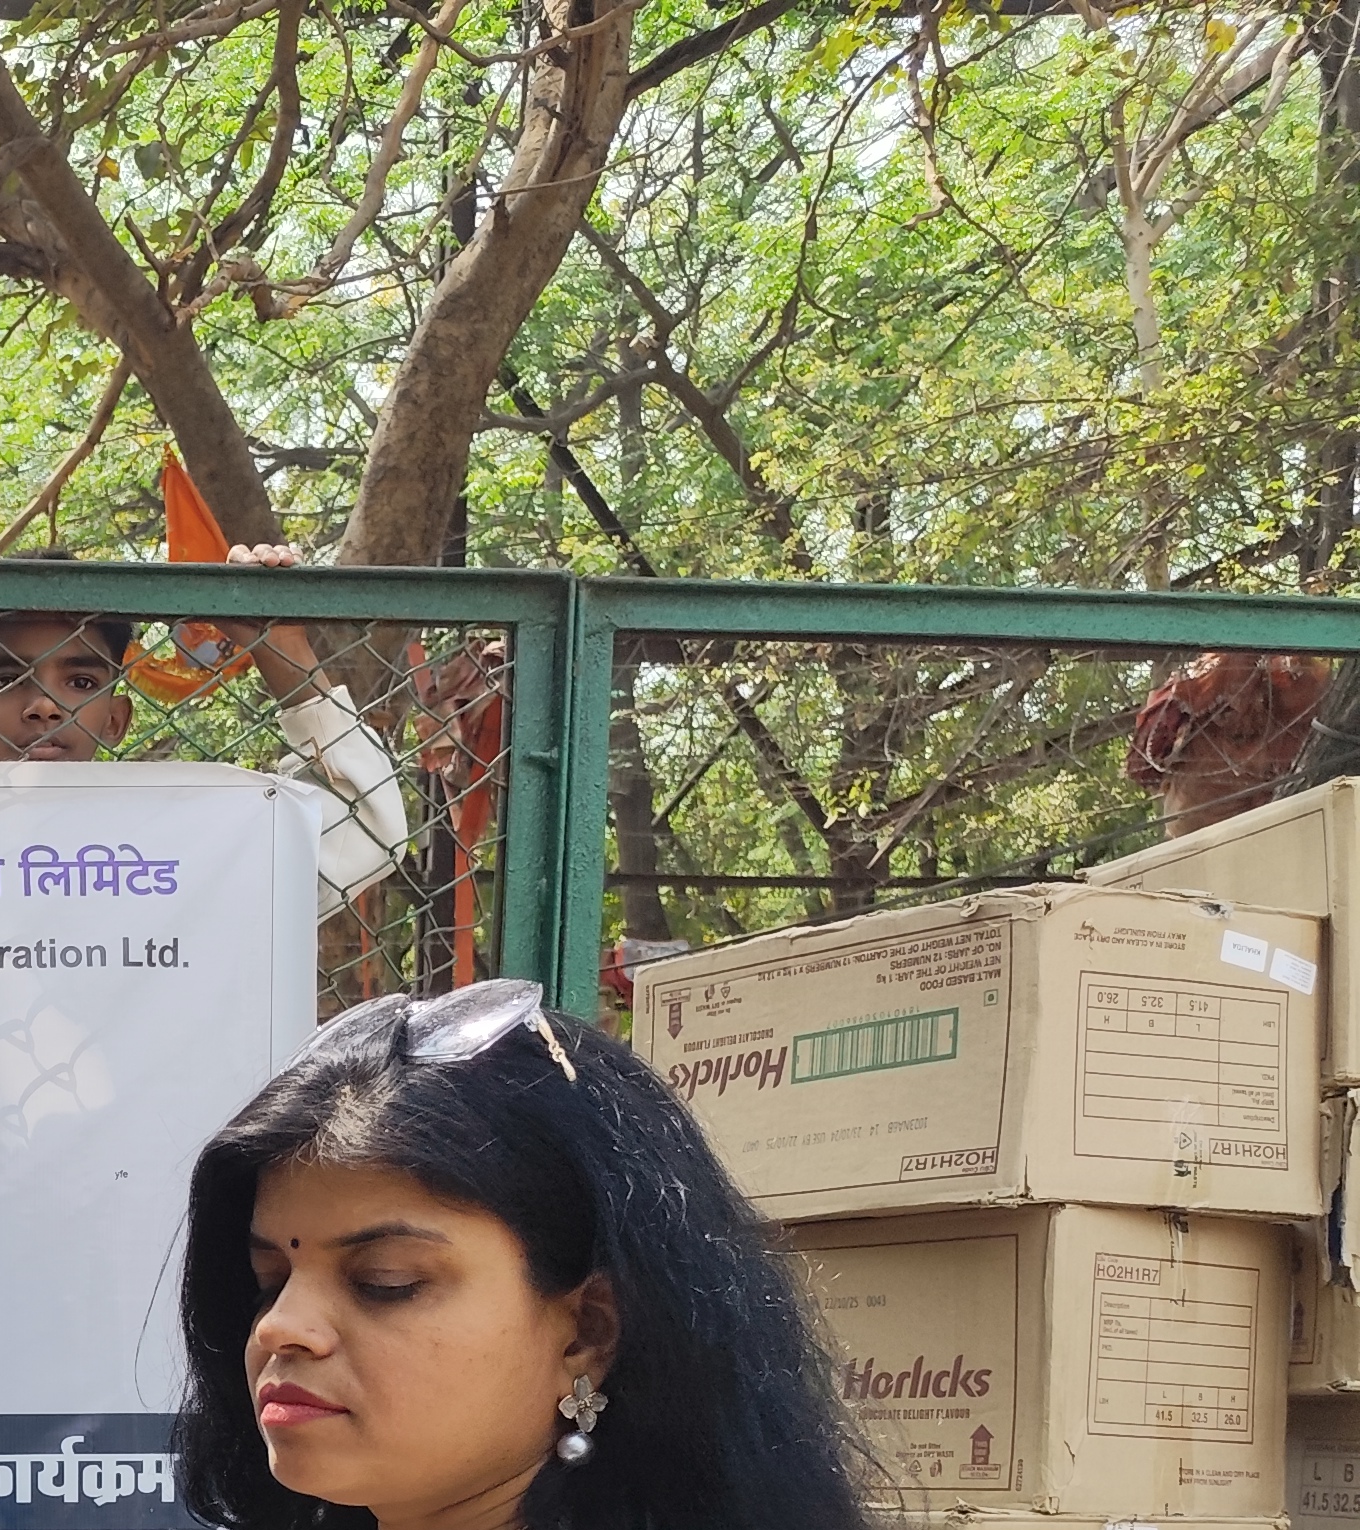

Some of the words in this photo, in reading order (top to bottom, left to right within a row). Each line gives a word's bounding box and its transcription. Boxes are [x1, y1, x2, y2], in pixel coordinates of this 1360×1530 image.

[18, 843, 180, 897] लिमिटेड
[955, 934, 971, 945] NET
[974, 928, 1001, 940] TOTAL
[909, 944, 920, 953] OF
[921, 936, 954, 951] WEIGHT
[972, 944, 984, 955] OF
[986, 941, 1001, 952] NO.
[122, 936, 190, 968] Ltd.
[890, 948, 906, 958] THE
[933, 952, 942, 962] 12
[944, 947, 970, 960] JARS:
[890, 955, 931, 970] NUMBERS
[948, 959, 983, 973] WEIGHT
[984, 955, 1001, 967] NET
[916, 968, 932, 979] THE
[934, 966, 946, 975] OF
[920, 979, 944, 991] FOOD
[1097, 991, 1119, 1004] 26.0
[1141, 996, 1164, 1008] 32.5
[1189, 1000, 1209, 1013] 41.5
[1103, 1015, 1110, 1024] H
[1148, 1019, 1154, 1028] B
[669, 1045, 788, 1102] Horlicks
[1212, 1141, 1286, 1160] HO2H1R7
[904, 1150, 995, 1172] HO2H1R7
[1096, 1264, 1159, 1282] HO2H1R7
[842, 1354, 992, 1400] Horlicks
[903, 1408, 934, 1420] DELIGHT
[936, 1408, 970, 1419] FLAVOUR
[1155, 1410, 1173, 1422] 41.5
[1191, 1412, 1208, 1423] 32.5
[1224, 1414, 1241, 1425] 26.0
[1313, 1462, 1322, 1481] L
[1344, 1463, 1354, 1482] B
